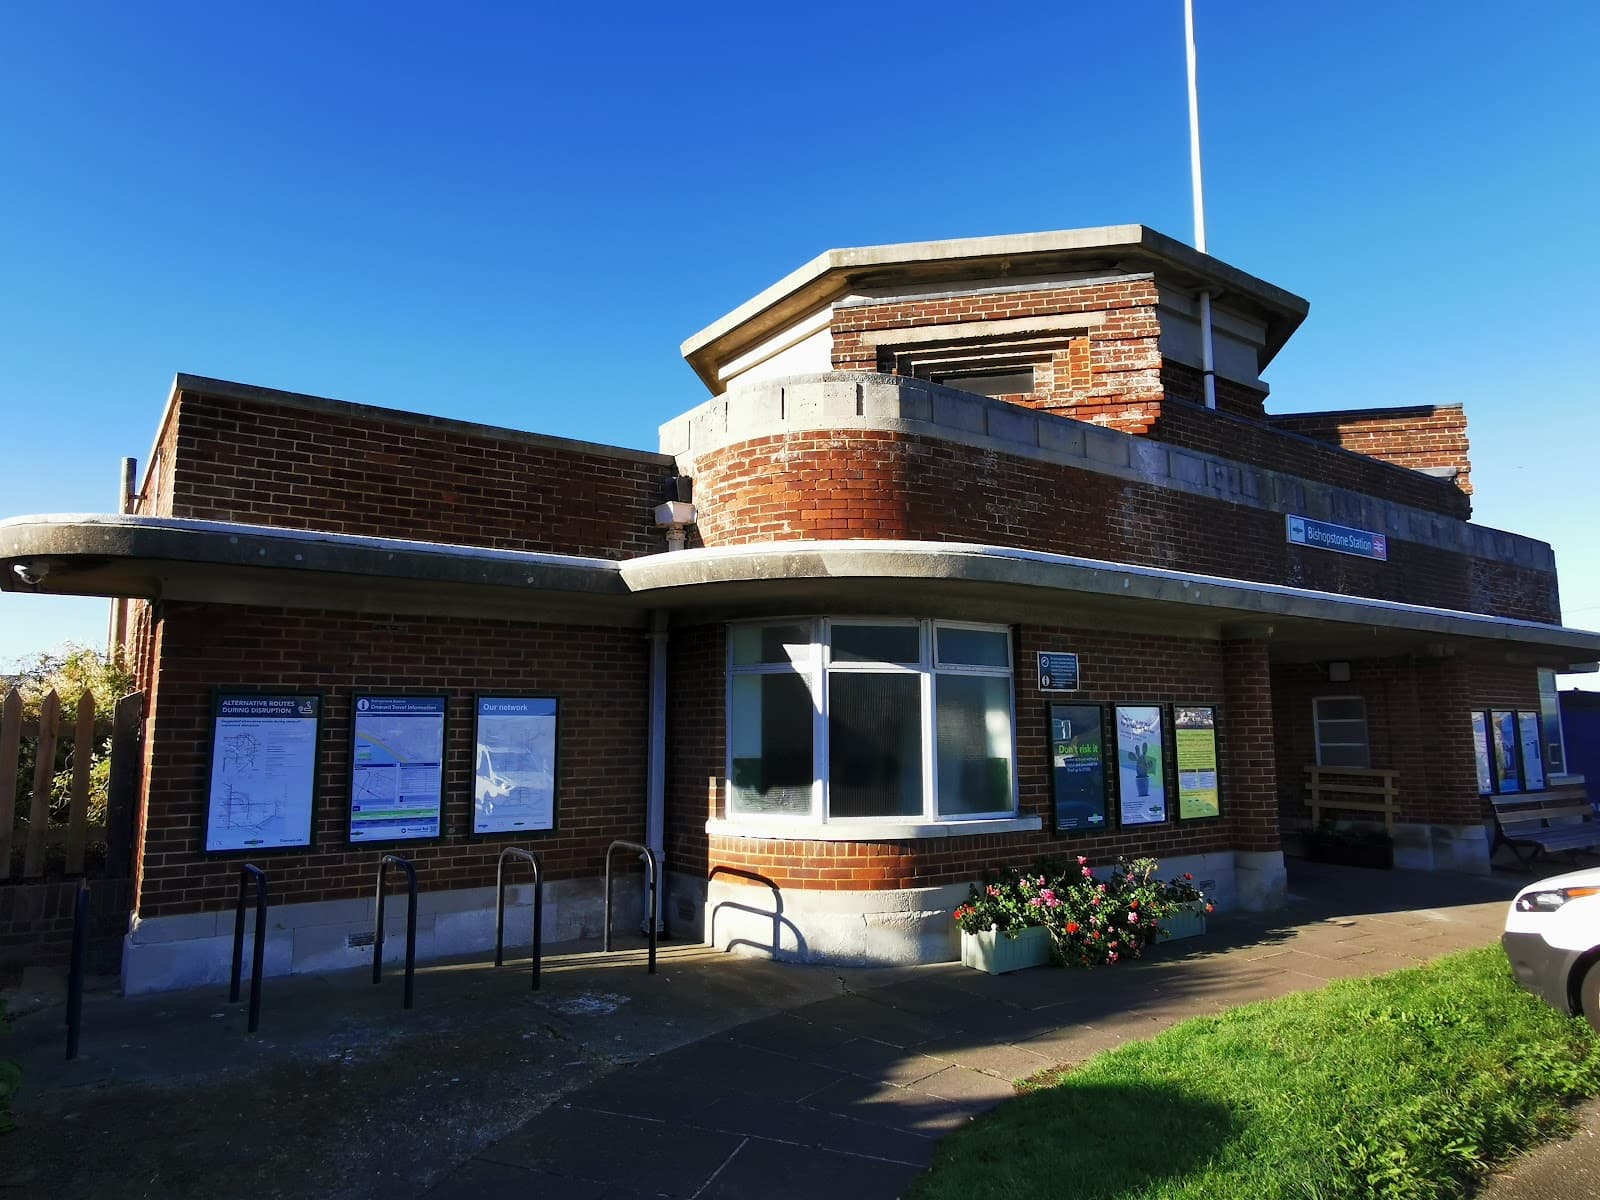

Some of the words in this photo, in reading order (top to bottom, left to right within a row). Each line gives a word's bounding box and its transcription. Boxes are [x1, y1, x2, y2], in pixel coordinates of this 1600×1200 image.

[1307, 527, 1349, 546] Bishopstone
[1349, 535, 1372, 552] Station
[483, 703, 497, 711] Our
[499, 703, 528, 711] network
[1058, 744, 1078, 754] Don't
[1080, 744, 1091, 753] risk
[1093, 744, 1098, 753] it
